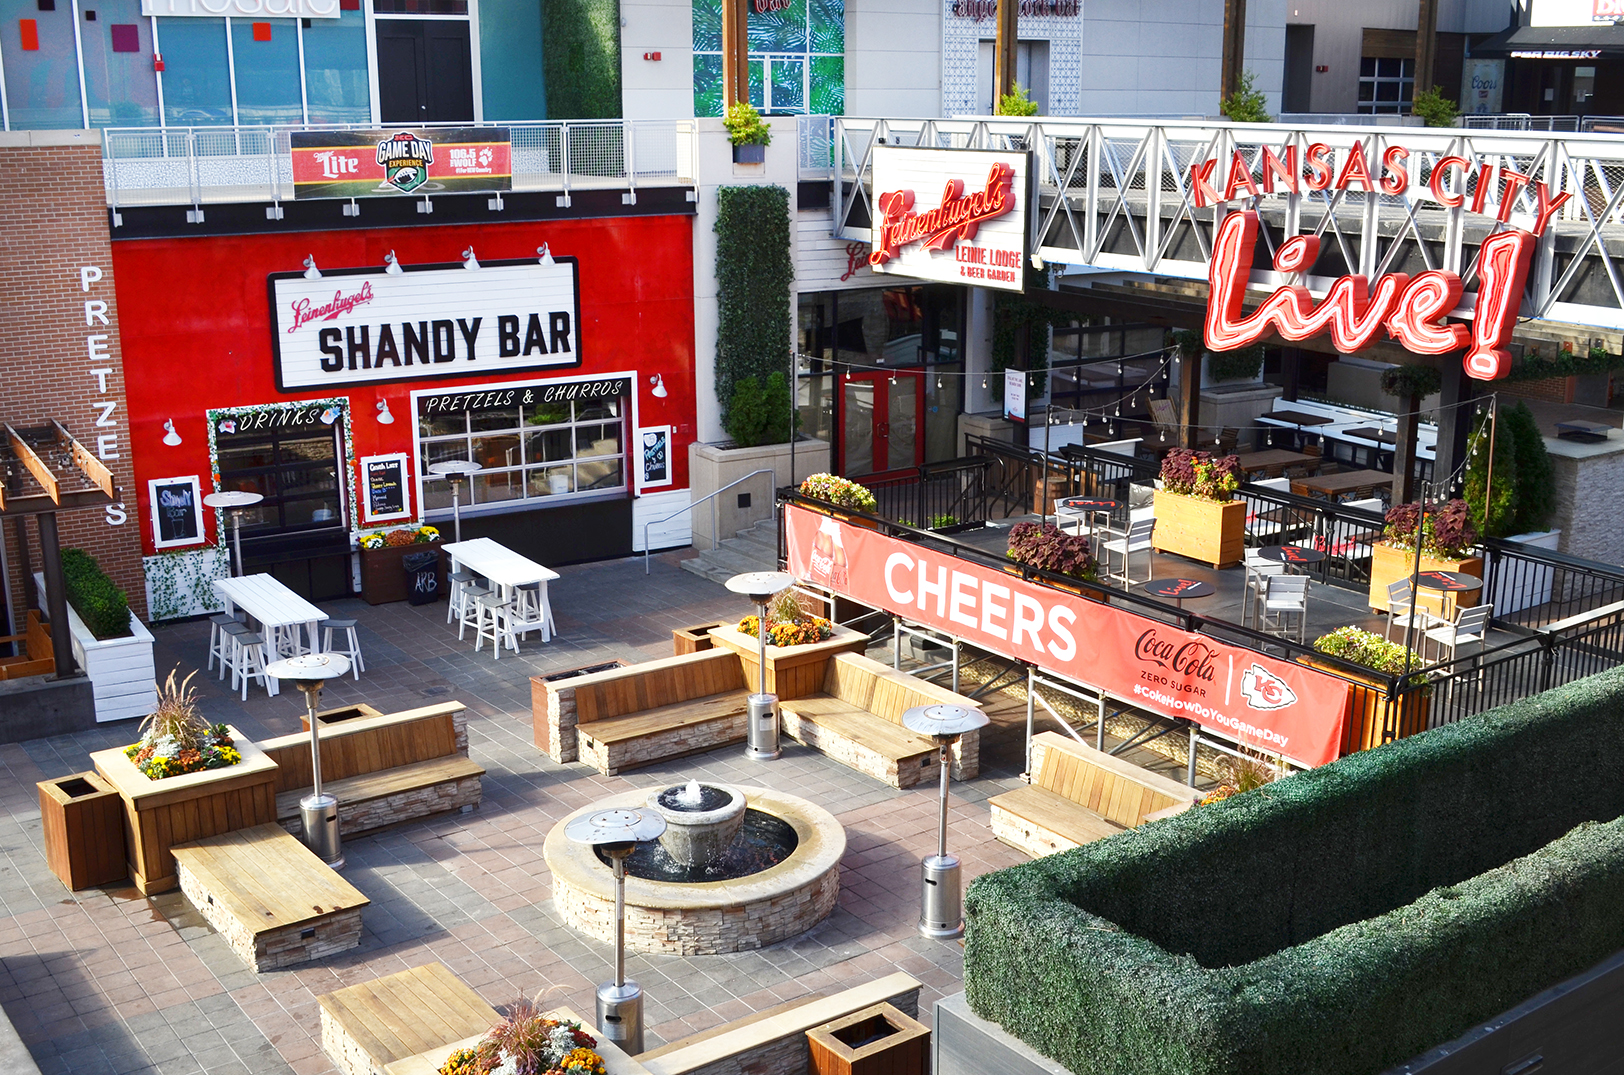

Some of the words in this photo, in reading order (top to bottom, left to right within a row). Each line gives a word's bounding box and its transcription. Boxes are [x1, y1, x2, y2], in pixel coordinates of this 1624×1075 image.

[1571, 49, 1602, 58] SKY
[1471, 75, 1497, 90] Coors
[378, 141, 409, 163] GAME
[410, 140, 434, 162] DAY
[388, 159, 423, 168] EXPERIENCE
[449, 148, 476, 159] 106.5
[454, 158, 477, 167] WOLF
[323, 153, 359, 179] Lite
[1190, 140, 1411, 208] KANSAS
[1430, 155, 1574, 238] CITY
[955, 245, 987, 265] LEINIE
[990, 248, 1022, 269] LODGE
[967, 267, 985, 280] BEER
[987, 268, 1016, 283] GARDEN
[1204, 209, 1536, 380] Live!
[318, 317, 483, 373] SHANDY
[497, 311, 571, 358] BAR
[80, 266, 127, 526] PRETZES
[426, 390, 515, 413] PRETZELS
[523, 389, 534, 404] &
[544, 380, 624, 403] CHURROS
[240, 408, 320, 431] DRINKS
[884, 552, 1077, 662] CHEERS
[1140, 670, 1168, 686] ZERO
[1171, 680, 1207, 698] SUGAR
[1133, 683, 1289, 748] #CokeHowDoYouGameDay
